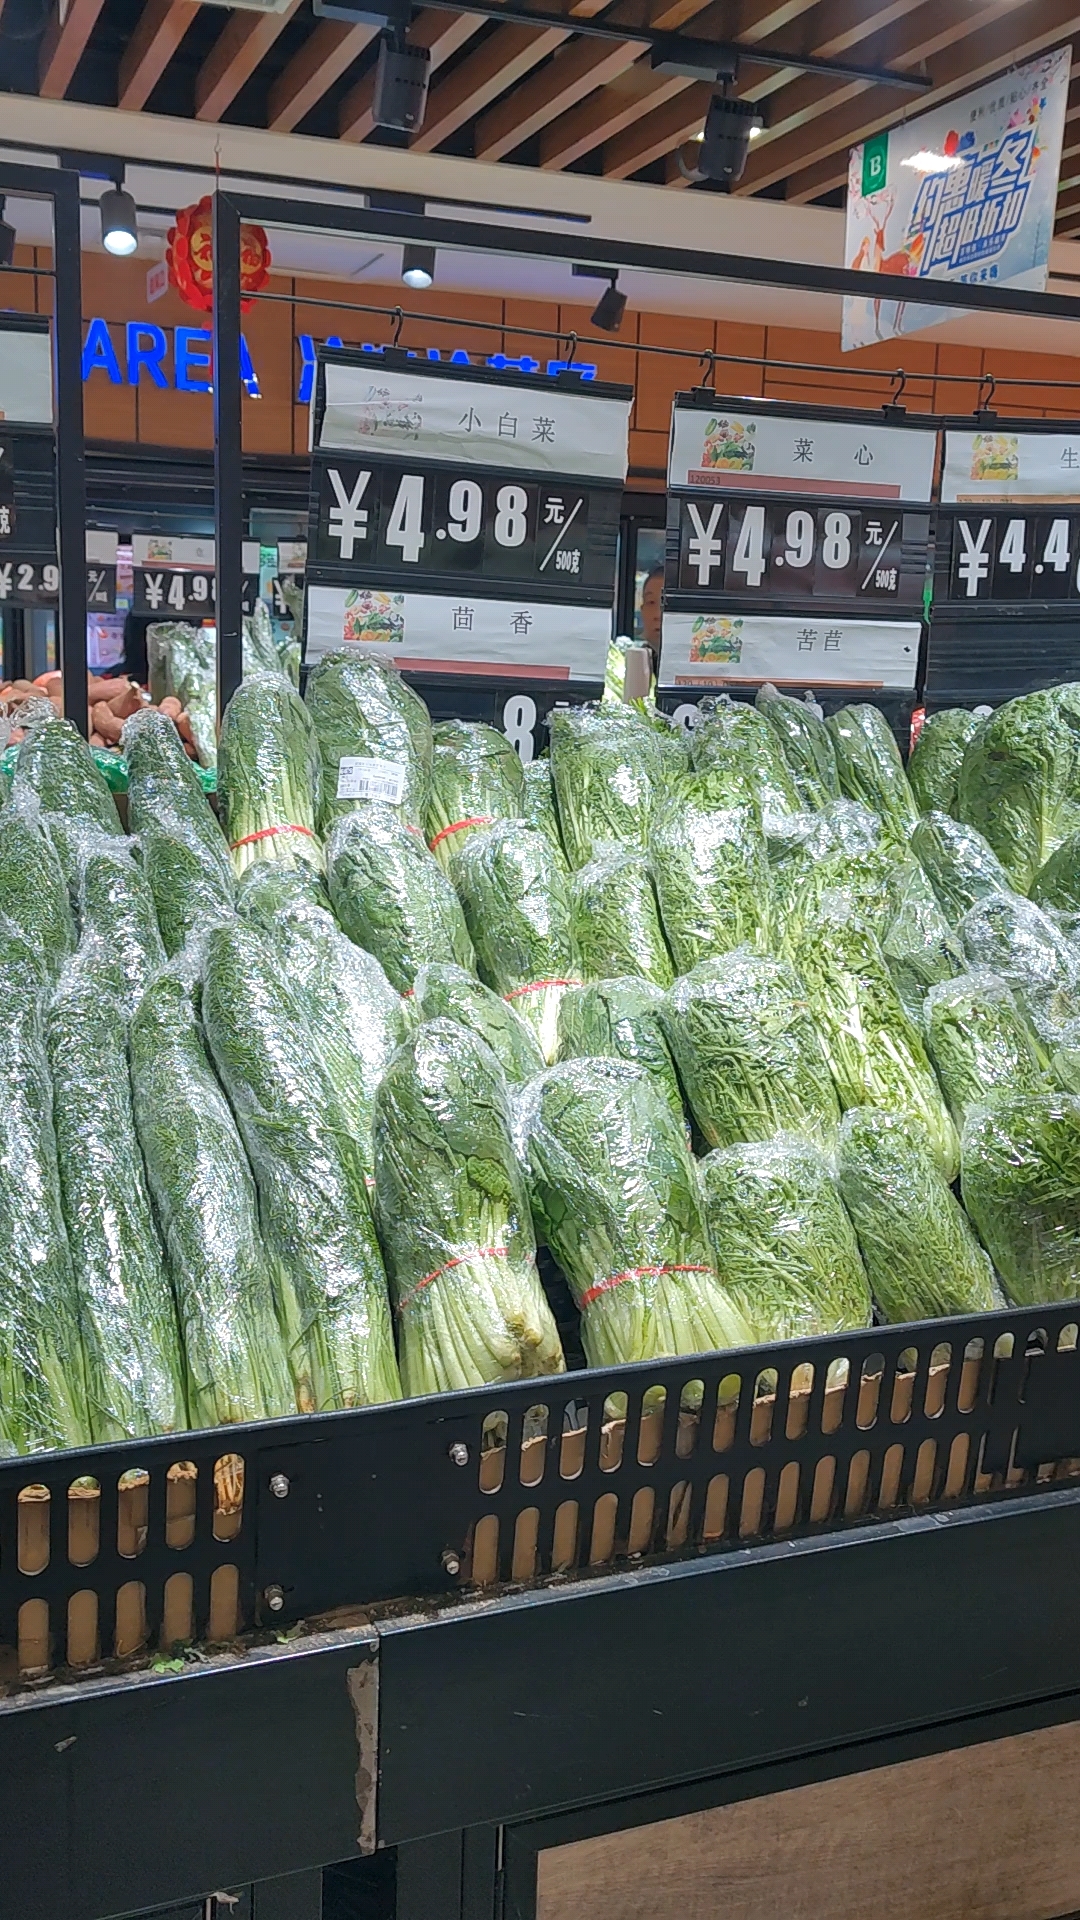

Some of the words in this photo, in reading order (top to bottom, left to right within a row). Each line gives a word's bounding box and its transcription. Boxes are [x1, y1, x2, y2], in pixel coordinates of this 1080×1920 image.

[458, 406, 557, 444] 小白菜
[792, 437, 875, 468] 菜心
[1060, 446, 1080, 469] 生
[326, 468, 529, 563] ¥4.98
[686, 503, 852, 588] ¥4.98
[957, 518, 1080, 598] ¥4.4
[452, 606, 534, 636] 茴香
[796, 628, 844, 653] 苦苣
